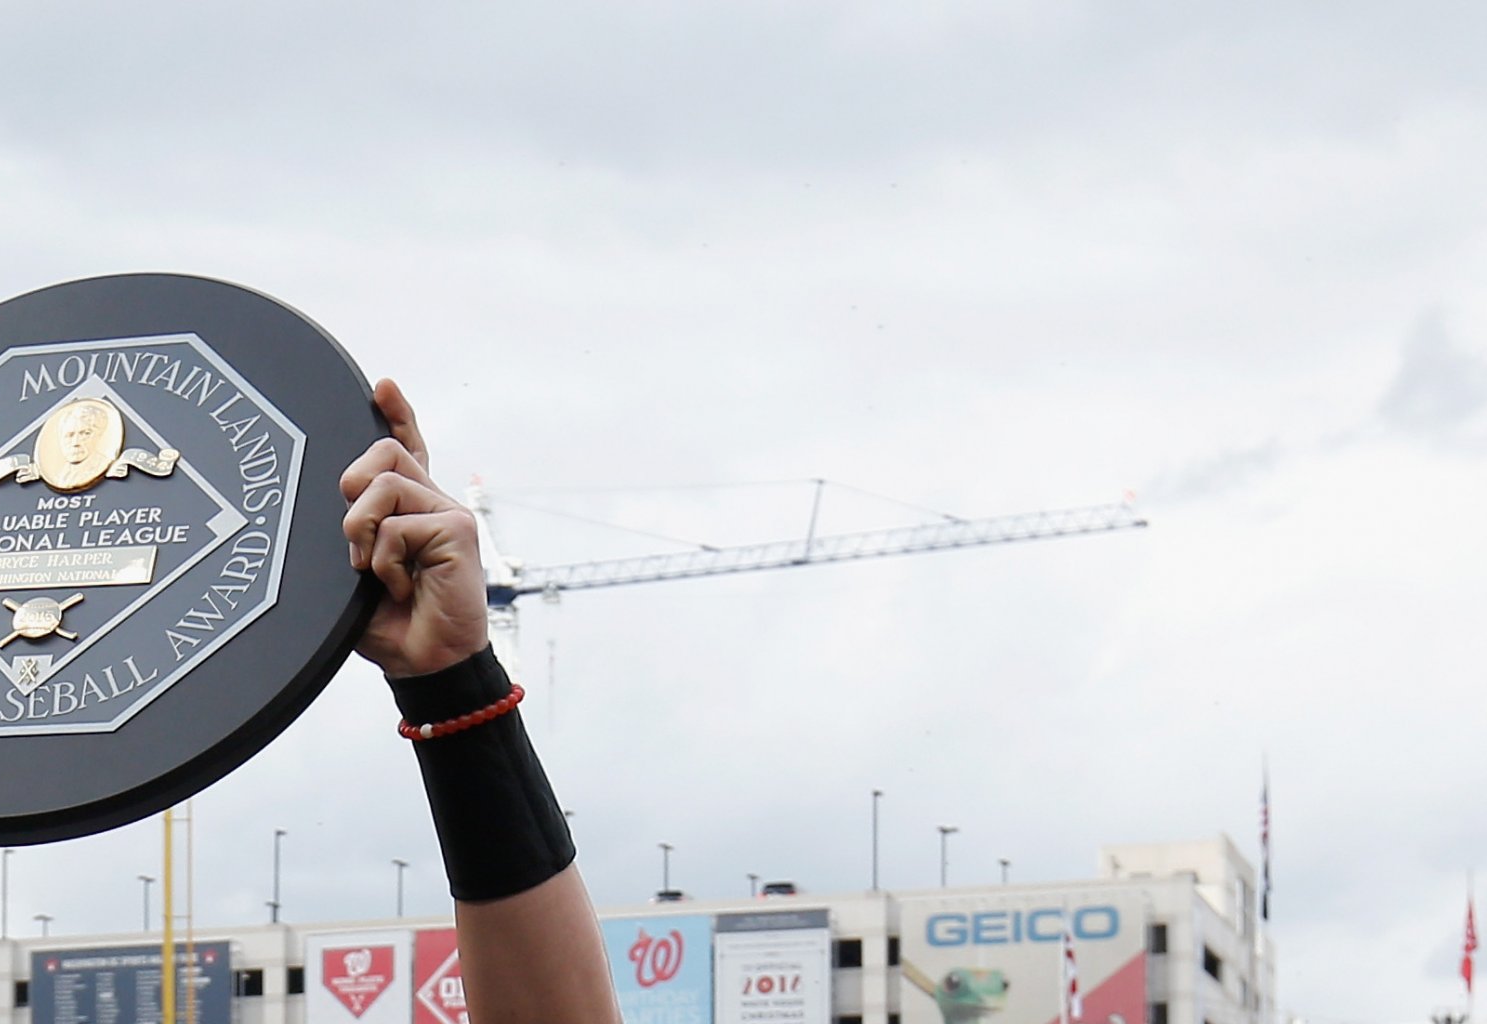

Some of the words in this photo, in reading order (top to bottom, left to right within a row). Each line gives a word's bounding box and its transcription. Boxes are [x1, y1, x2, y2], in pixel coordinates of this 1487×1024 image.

[19, 352, 225, 407] MOUNTAIN
[209, 391, 282, 513] LANDIS
[37, 494, 97, 511] MOST
[78, 507, 163, 527] PLAYER
[81, 524, 190, 548] LEAGUE
[46, 552, 114, 568] HARPER
[164, 530, 272, 662] AWARD
[925, 905, 1120, 947] GEICO
